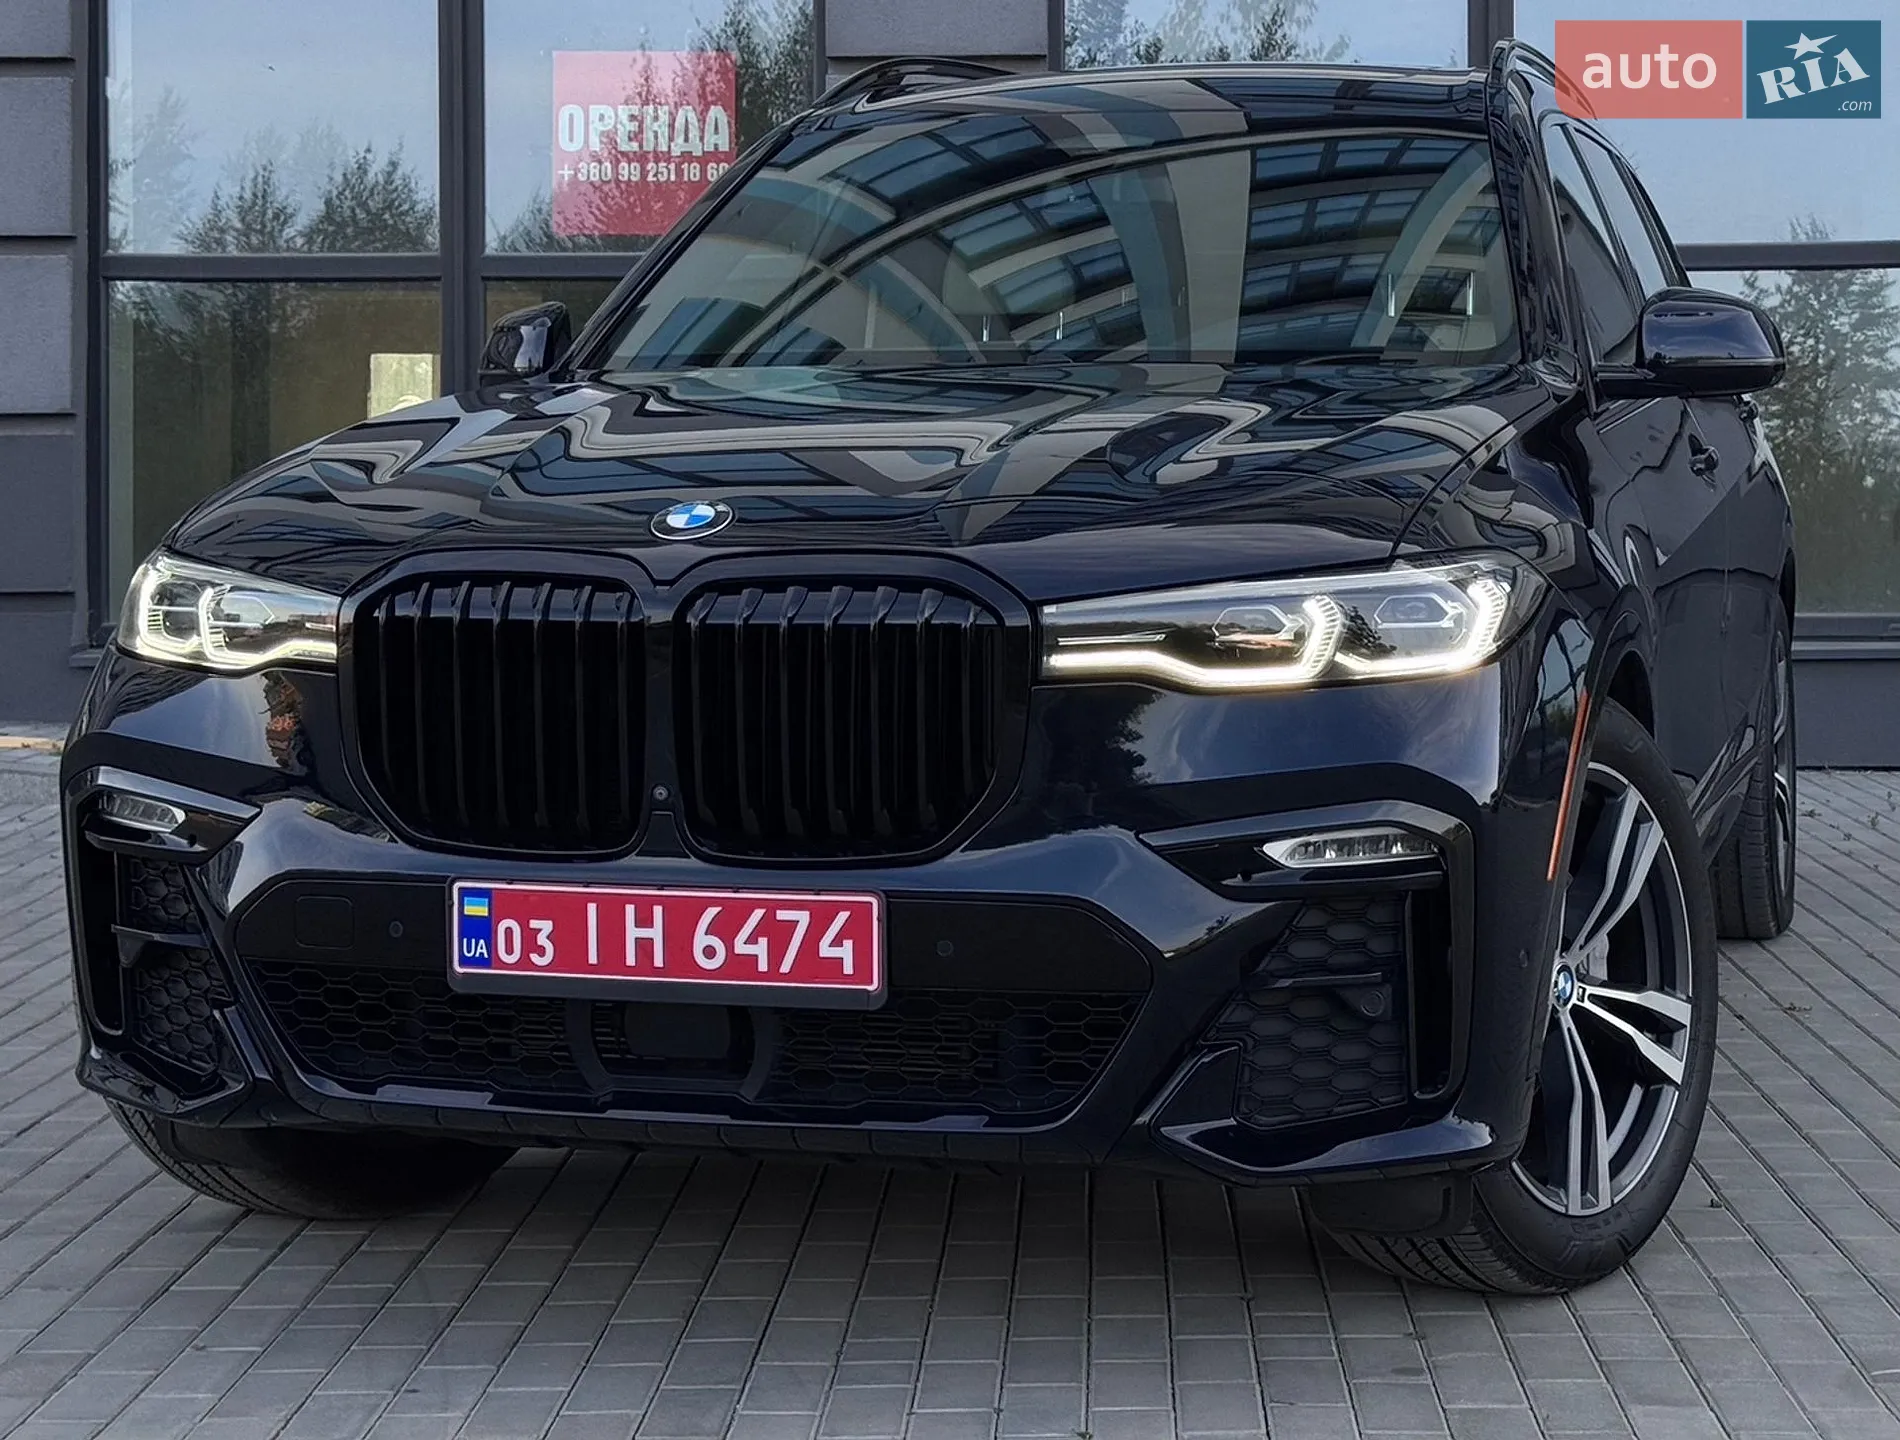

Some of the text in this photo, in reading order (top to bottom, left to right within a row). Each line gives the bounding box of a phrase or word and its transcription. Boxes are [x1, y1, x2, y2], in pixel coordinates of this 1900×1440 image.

[558, 104, 730, 156] ОРЕНДА
[618, 162, 641, 182] 99
[647, 162, 676, 182] 251
[462, 938, 489, 959] UA
[497, 919, 555, 967] 03
[693, 906, 855, 975] 6474
